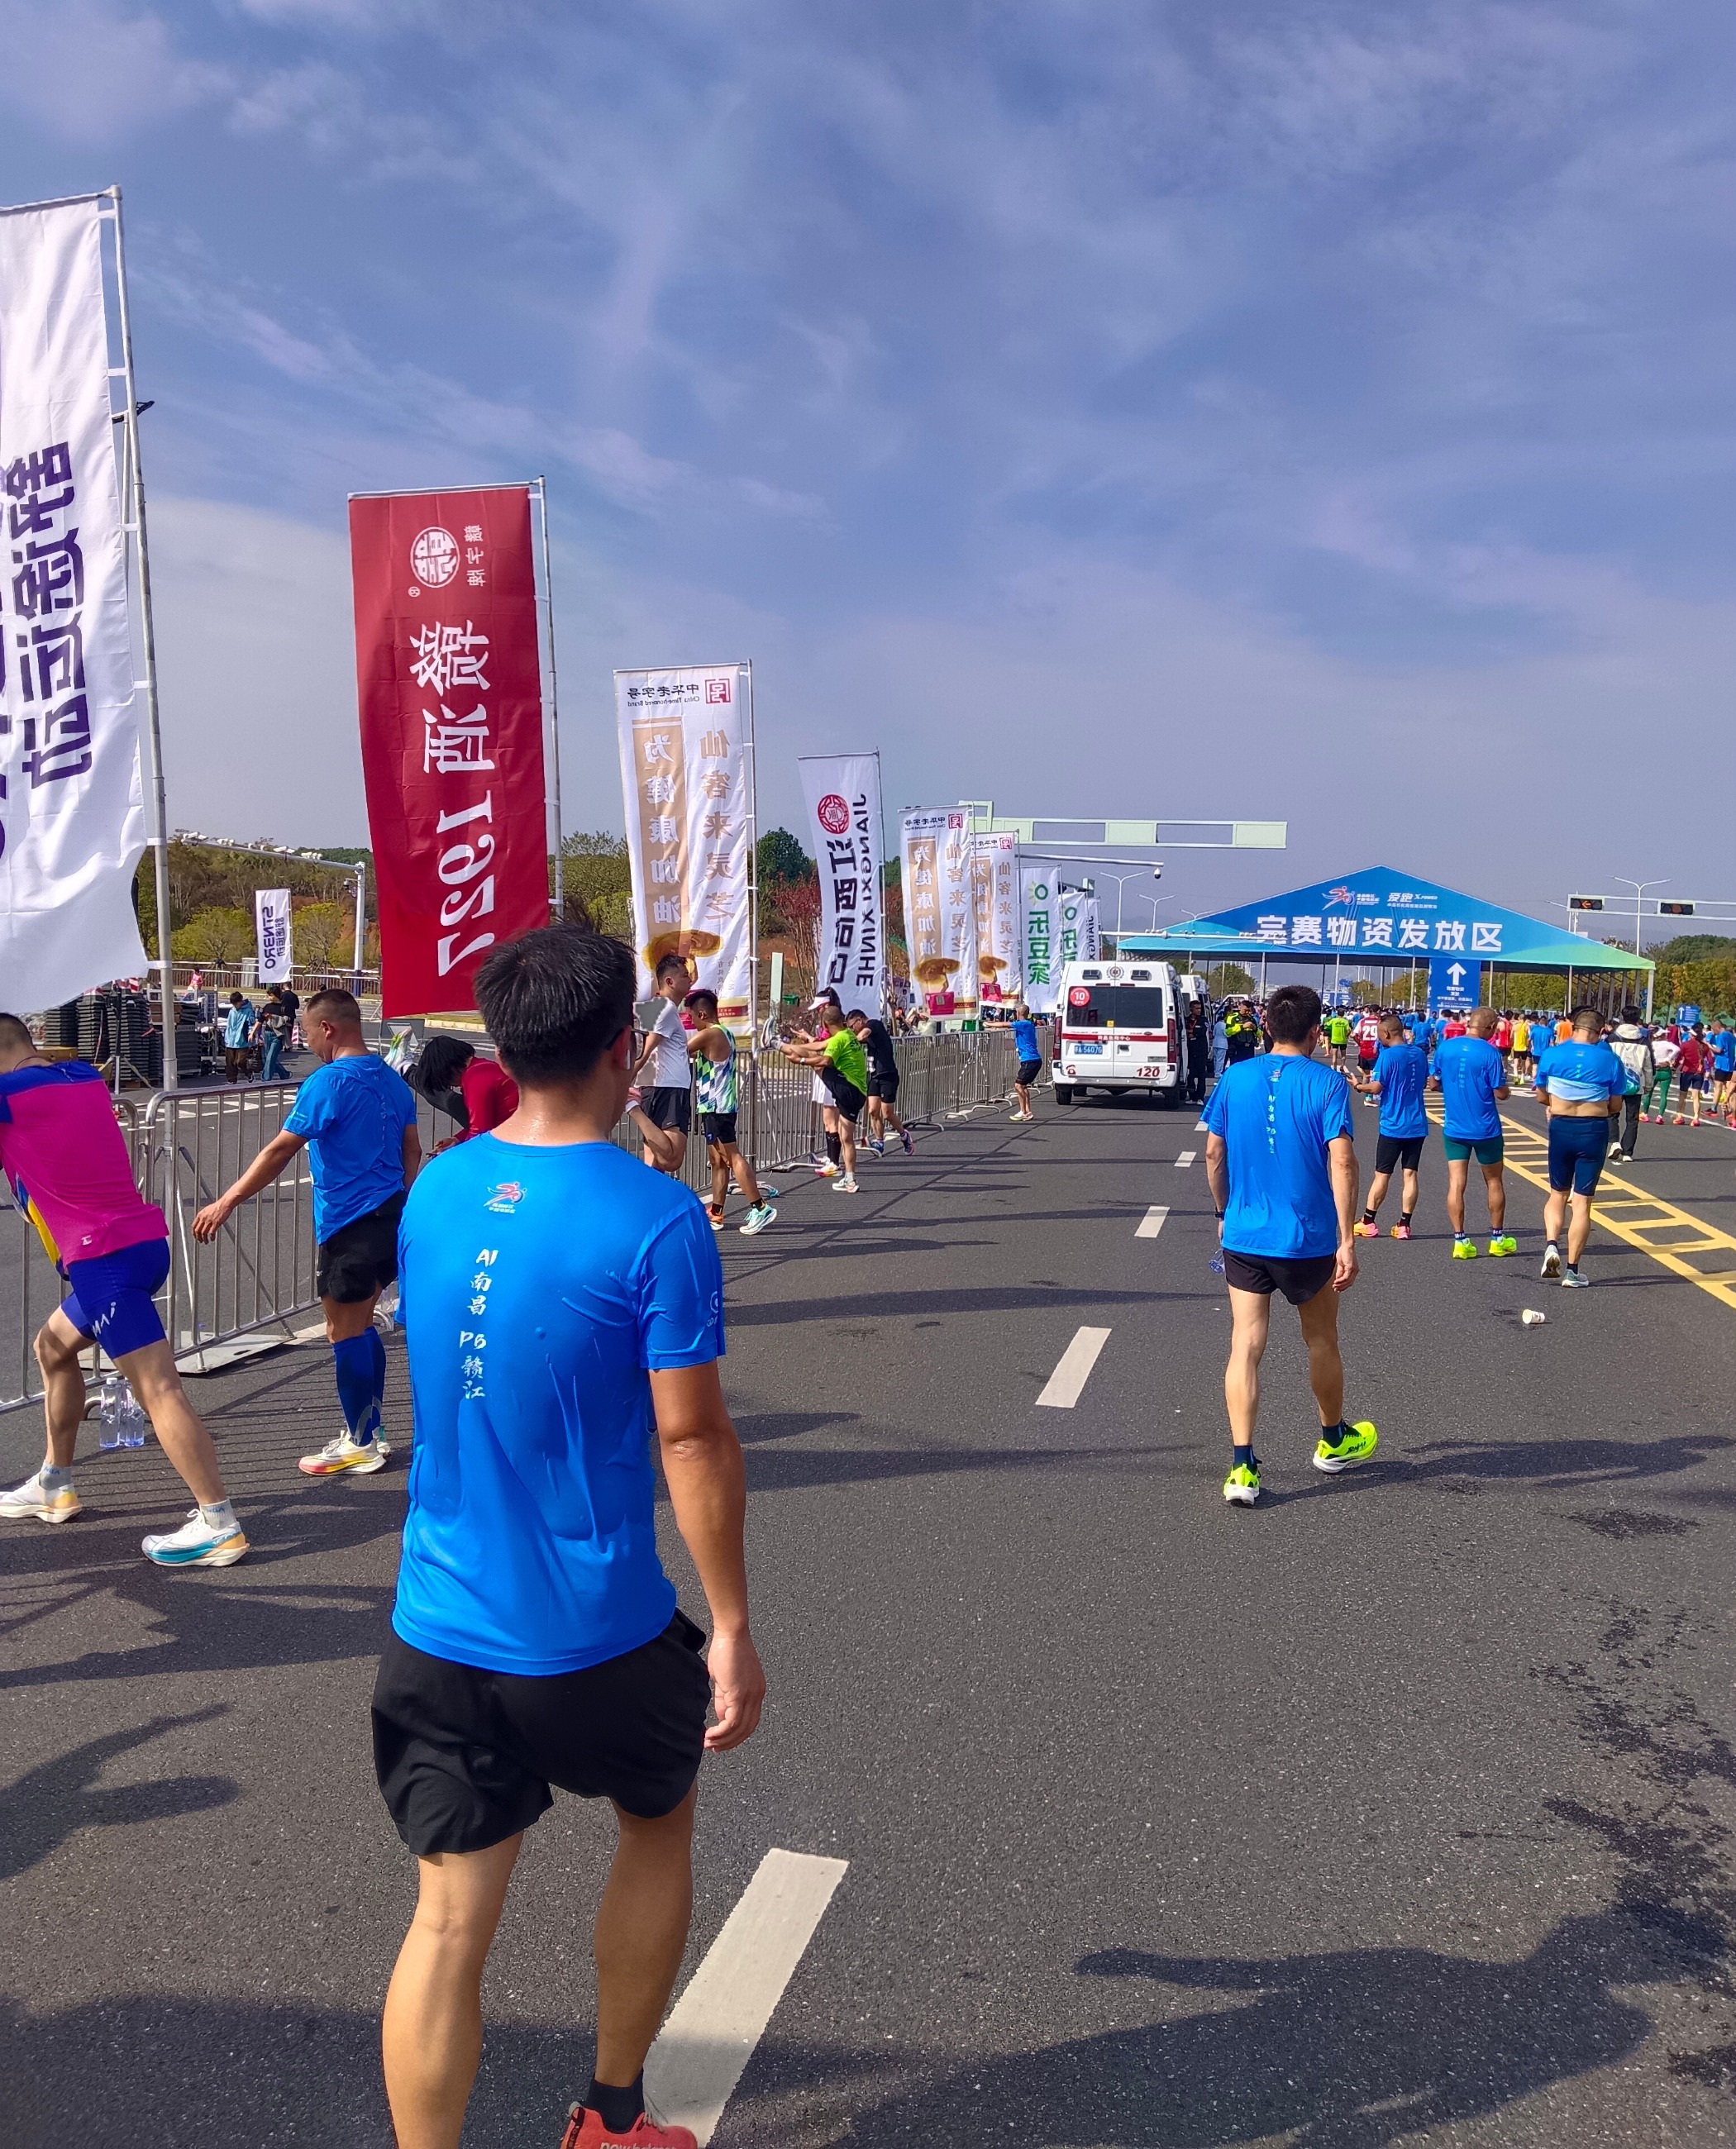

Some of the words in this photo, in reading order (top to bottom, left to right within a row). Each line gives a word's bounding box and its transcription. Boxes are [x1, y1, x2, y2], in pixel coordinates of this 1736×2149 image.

[1257, 915, 1503, 951] 完赛物资发放区
[1075, 992, 1085, 1000] 10
[1362, 1026, 1378, 1041] 29
[1137, 1068, 1161, 1077] 120
